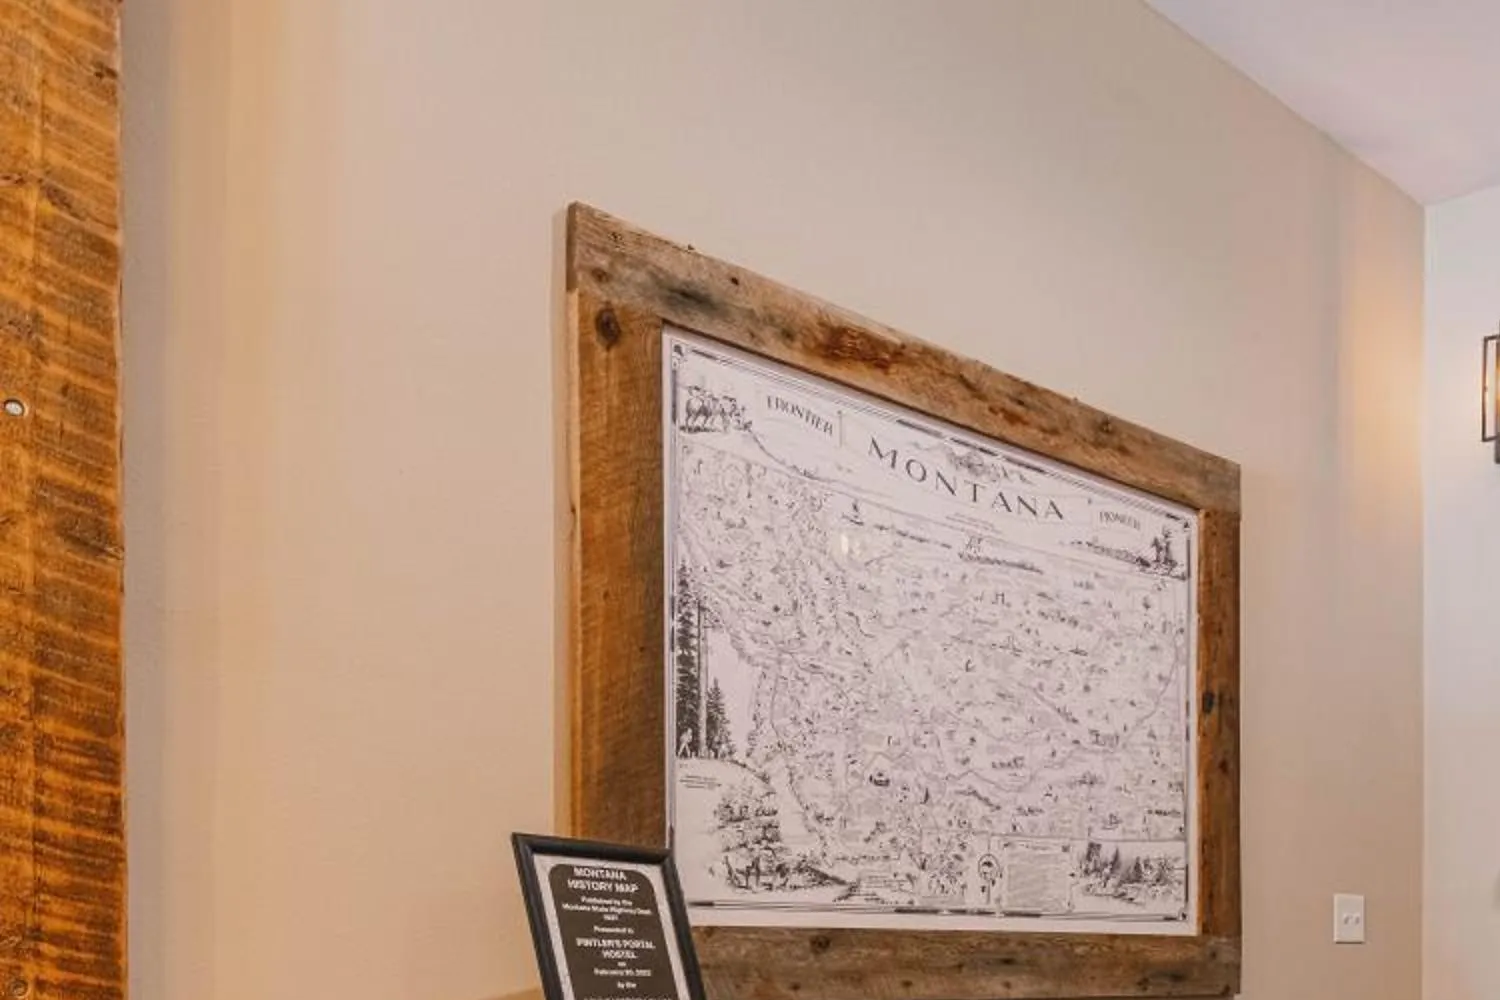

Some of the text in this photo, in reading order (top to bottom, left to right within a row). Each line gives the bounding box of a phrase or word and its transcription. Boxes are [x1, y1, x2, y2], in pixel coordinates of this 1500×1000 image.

[868, 436, 1063, 520] MONTANA
[574, 866, 627, 881] MONTANA
[567, 879, 640, 893] HISTORY MAP
